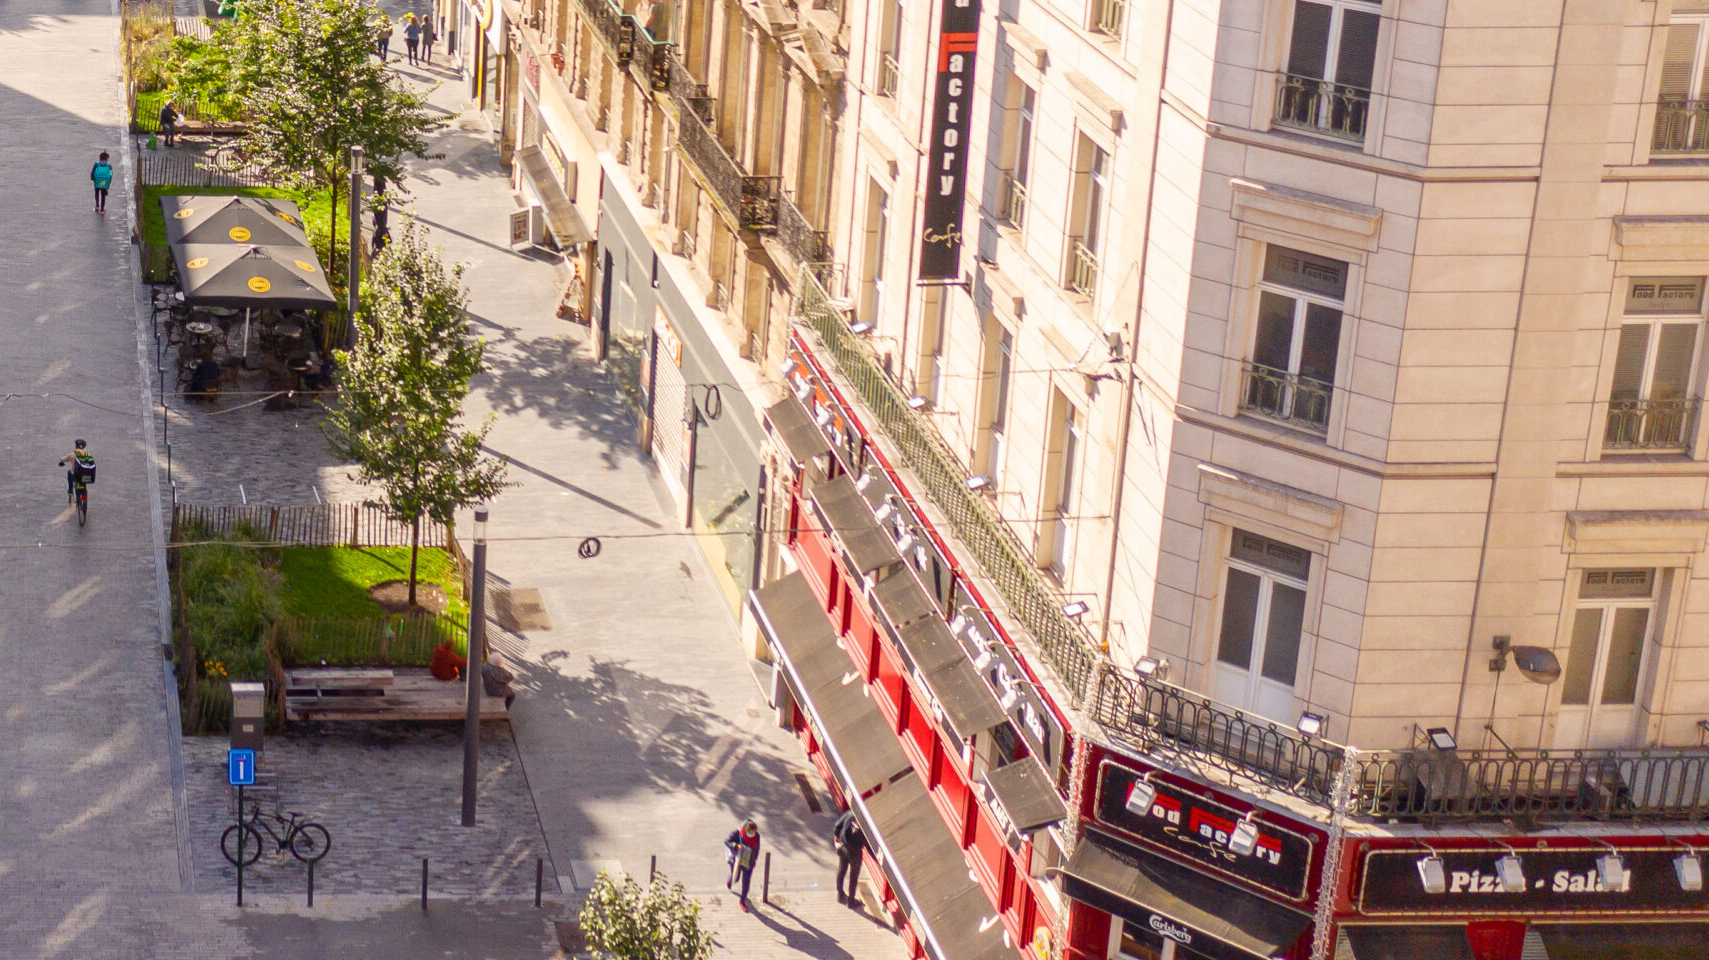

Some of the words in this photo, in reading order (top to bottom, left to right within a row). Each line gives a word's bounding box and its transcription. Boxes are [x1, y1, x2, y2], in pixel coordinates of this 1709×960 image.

[938, 32, 978, 197] Factory
[1189, 806, 1282, 866] Facry
[1149, 914, 1192, 944] Carlsberg
